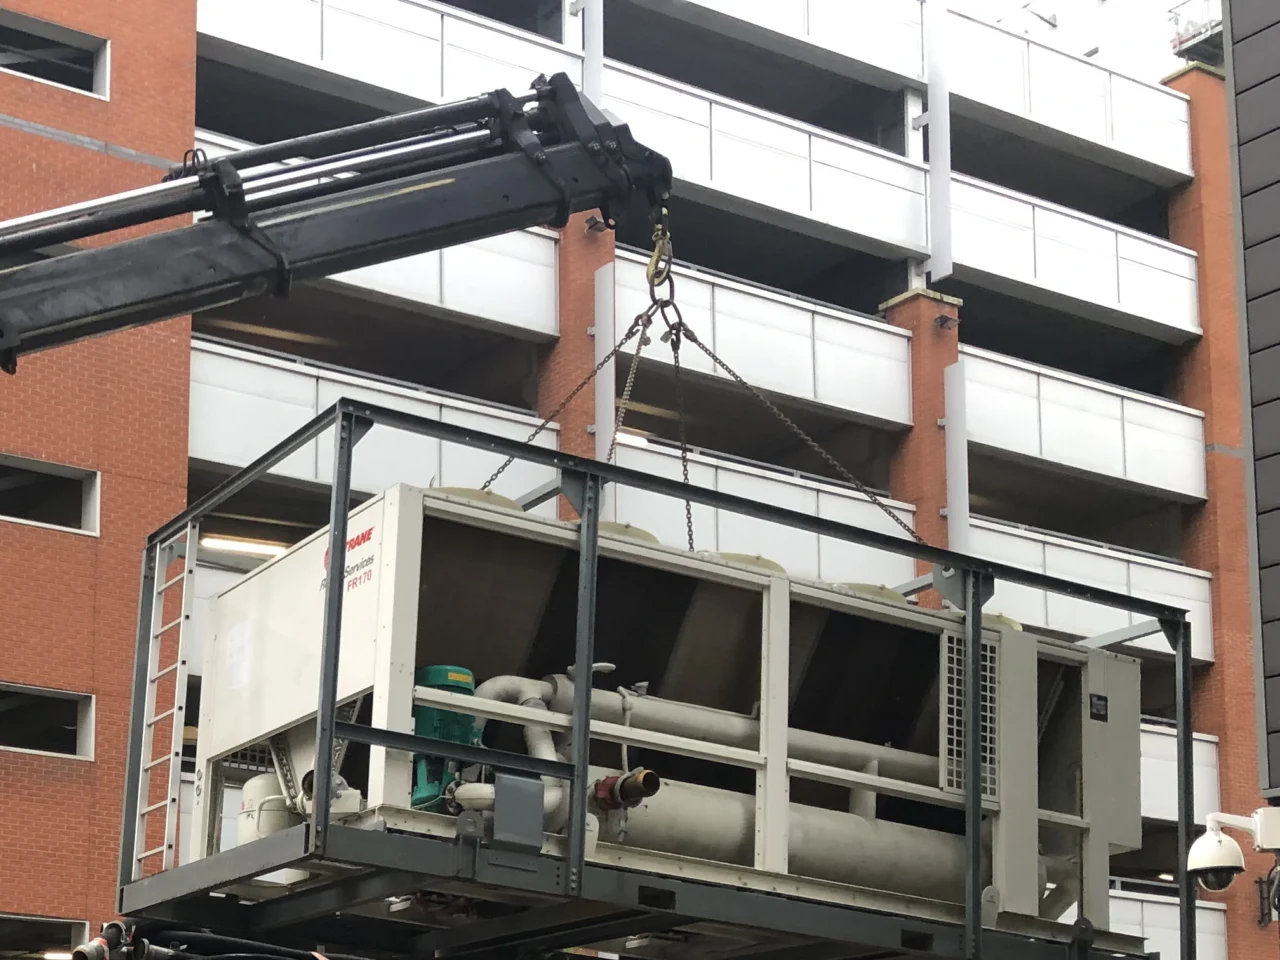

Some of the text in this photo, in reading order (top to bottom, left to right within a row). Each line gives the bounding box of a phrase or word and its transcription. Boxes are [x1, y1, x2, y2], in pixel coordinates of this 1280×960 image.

[346, 526, 375, 552] TRANE
[344, 554, 375, 578] Services
[347, 569, 372, 592] FR170
